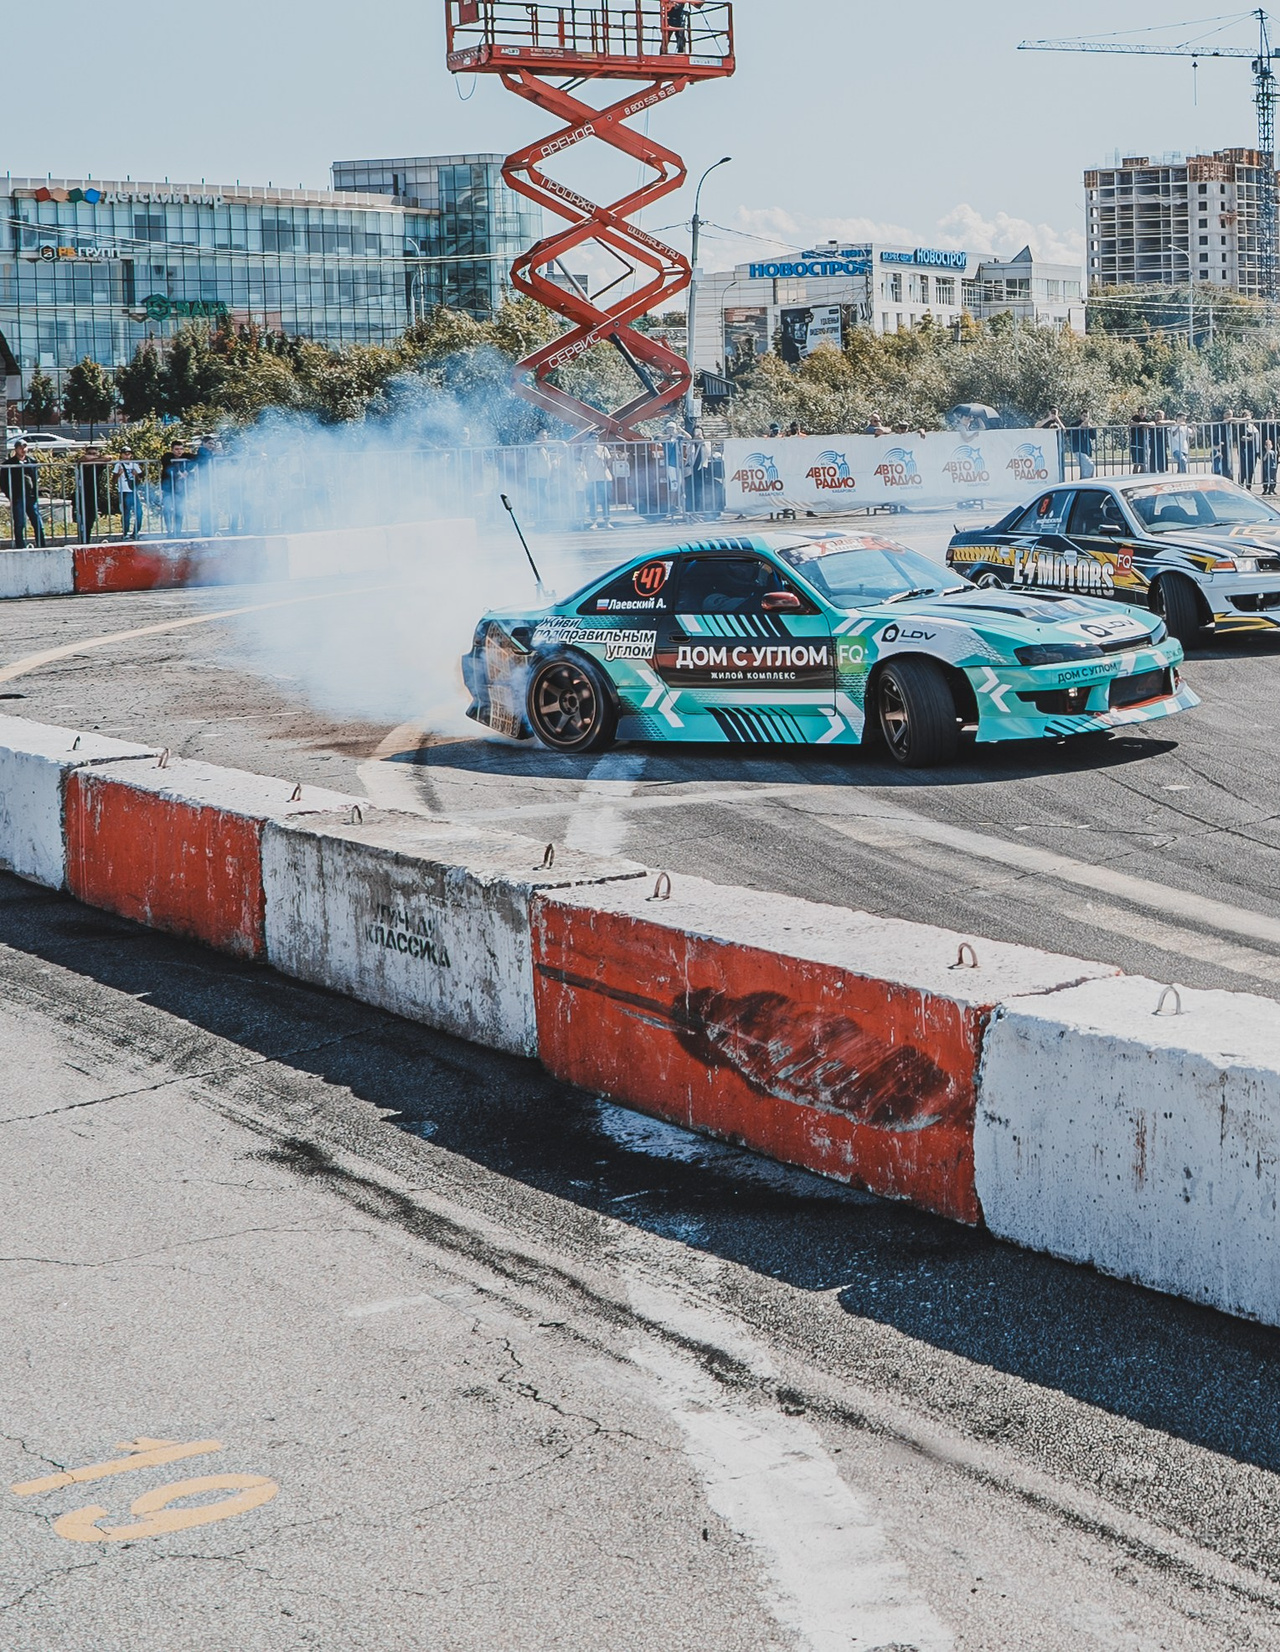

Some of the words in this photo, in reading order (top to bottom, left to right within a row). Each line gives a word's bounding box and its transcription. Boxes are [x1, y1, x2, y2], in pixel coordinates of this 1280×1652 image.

[540, 124, 595, 158] АРЕНДА
[540, 176, 597, 214] ПРОДАЖА
[548, 332, 601, 369] СЕРВИС
[874, 463, 905, 476] АВТО
[942, 460, 972, 473] АВТО
[1005, 458, 1033, 470] АВТО
[730, 469, 765, 482] АВТО
[805, 466, 837, 478] АВТО
[952, 470, 990, 483] РАДИО
[1014, 468, 1048, 480] РАДИО
[741, 479, 784, 493] РАДИО
[814, 476, 855, 489] РАДИО
[883, 474, 923, 486] РАДИО
[1117, 554, 1132, 568] FQ
[608, 597, 655, 610] Лаевский
[655, 598, 667, 609] А.
[562, 629, 655, 644] правильным
[901, 629, 937, 640] LDV
[607, 643, 654, 660] углом
[676, 646, 728, 669] ДОМ
[732, 646, 748, 666] С
[751, 645, 828, 667] УГЛОМ
[838, 645, 865, 664] FQ
[710, 669, 744, 680] ЖИЛОЙ
[746, 670, 797, 680] КОМПЛЕКС
[1057, 671, 1081, 684] ДОМ
[1088, 662, 1118, 676] УГЛОМ
